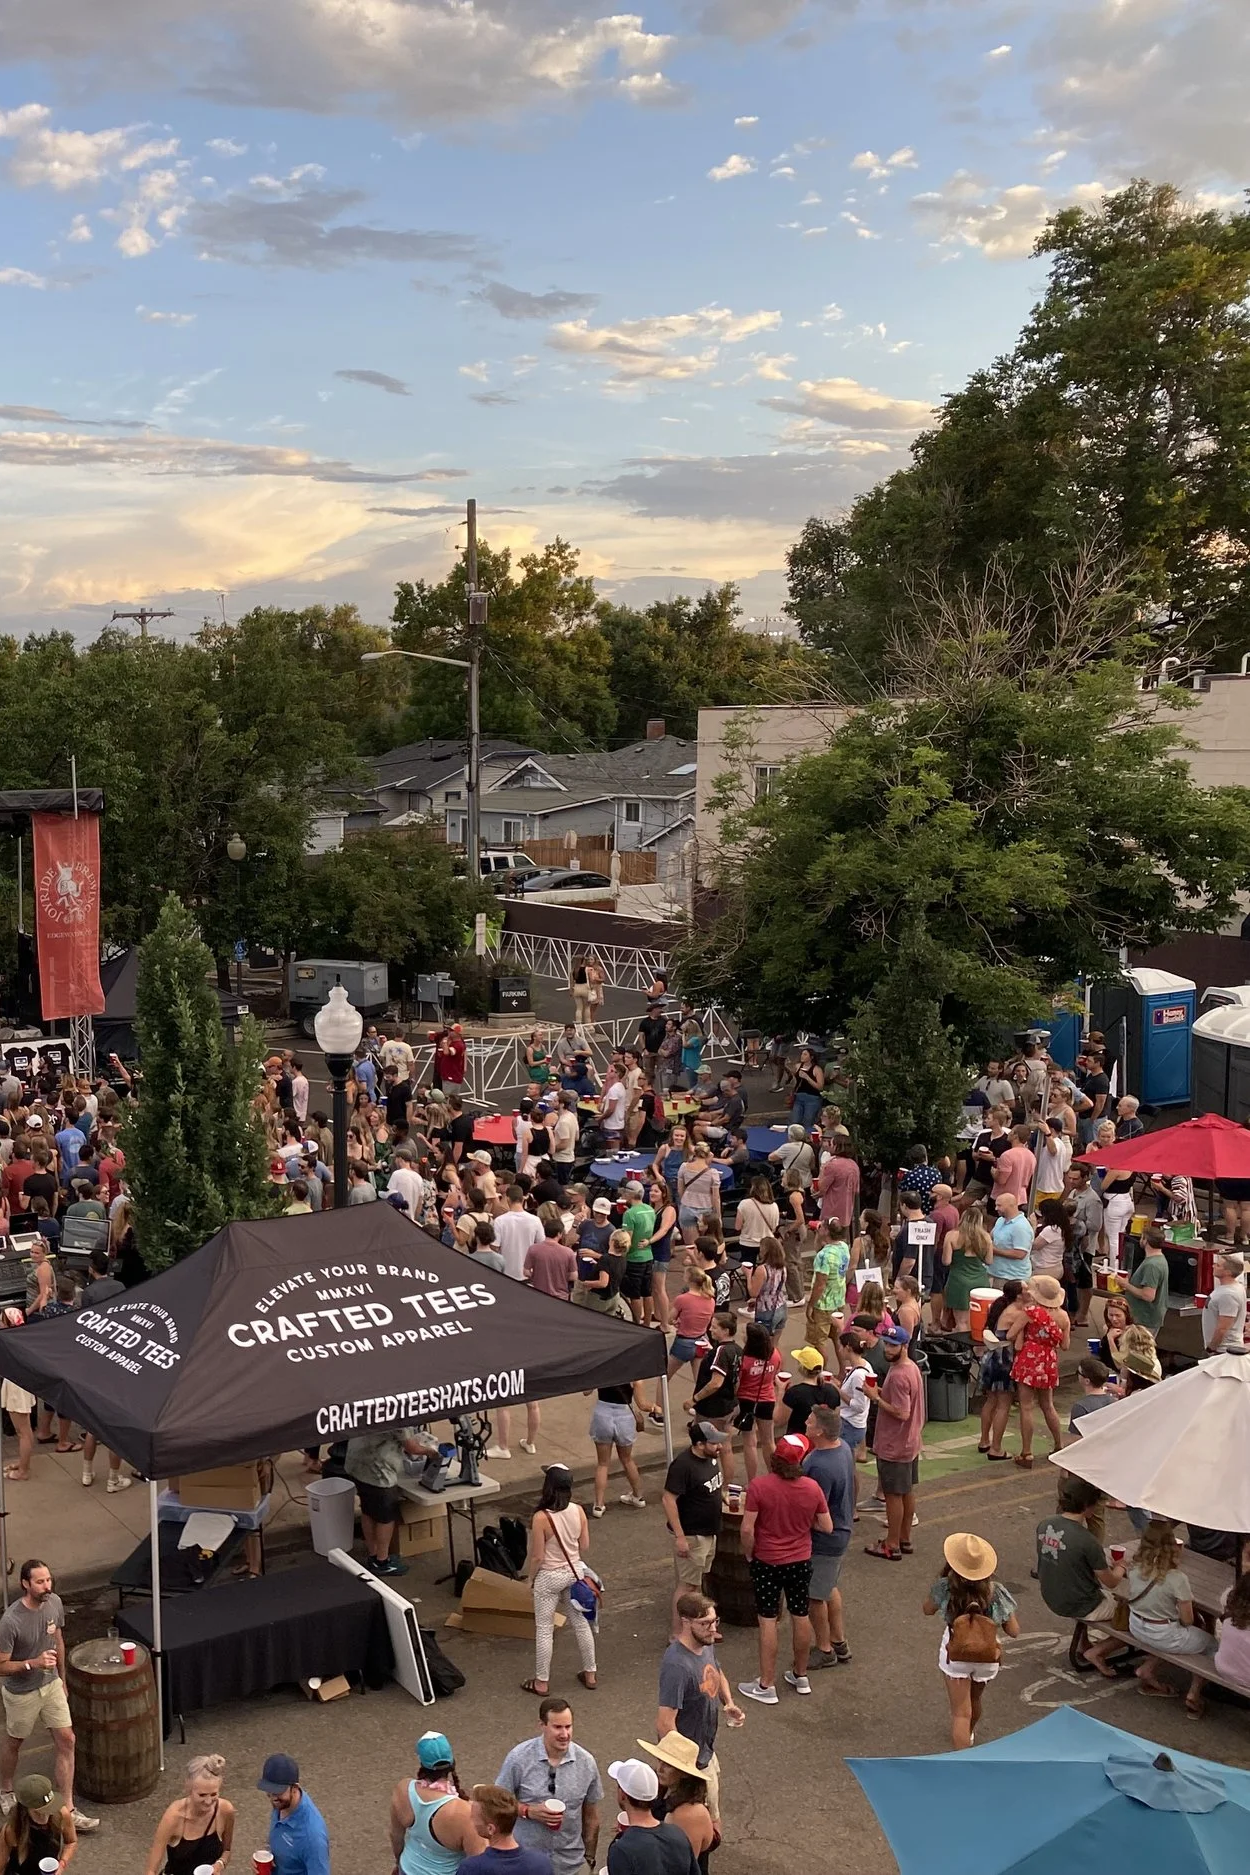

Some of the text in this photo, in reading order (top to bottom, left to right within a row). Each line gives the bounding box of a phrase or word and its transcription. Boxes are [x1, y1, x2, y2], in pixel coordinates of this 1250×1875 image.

[40, 862, 97, 923] JOYRIDE BREWING
[502, 990, 527, 998] PARKING
[255, 1264, 440, 1314] ELEVATE YOUR BRAND
[316, 1282, 374, 1301] MMXVI
[107, 1302, 179, 1344] ELEVATE YOUR BRAND
[130, 1314, 155, 1330] MMXVI
[227, 1283, 496, 1348] CRAFTED TEES
[75, 1333, 143, 1375] CUSTOM APPAREL
[76, 1310, 181, 1370] CRAFTED TEES
[286, 1320, 473, 1362] CUSTOM APPAREL
[316, 1368, 525, 1435] CRAFTEDTEESHATS.COM
